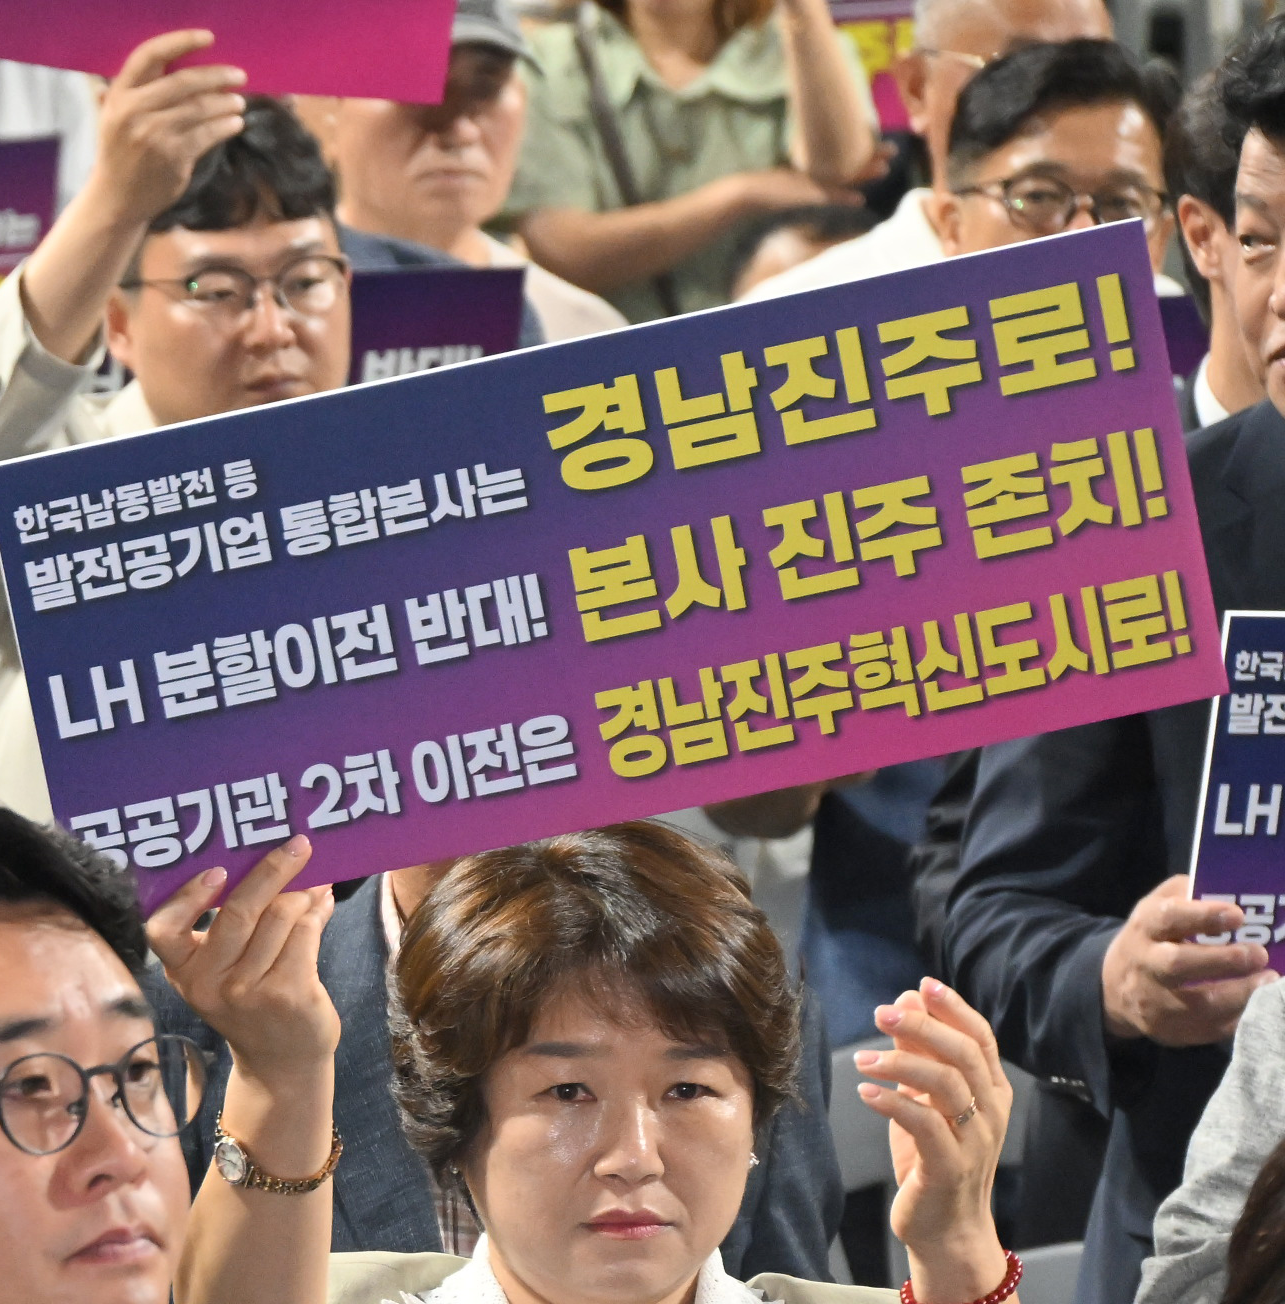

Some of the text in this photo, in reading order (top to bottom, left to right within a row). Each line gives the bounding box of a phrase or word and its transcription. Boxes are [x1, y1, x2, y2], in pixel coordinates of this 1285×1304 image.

[542, 273, 1136, 491] 경남진주로!
[13, 459, 258, 543] 한국남동발전 등
[24, 462, 528, 611] 발전공기업 통합본사는
[568, 427, 1169, 643] 본사 진주 존치!
[49, 574, 547, 740] LH 분할이전 반대!
[594, 570, 1192, 778] 경남진주혁신도시로!
[300, 748, 401, 829] 2차
[411, 714, 577, 807] 이전은
[1214, 784, 1283, 835] LH
